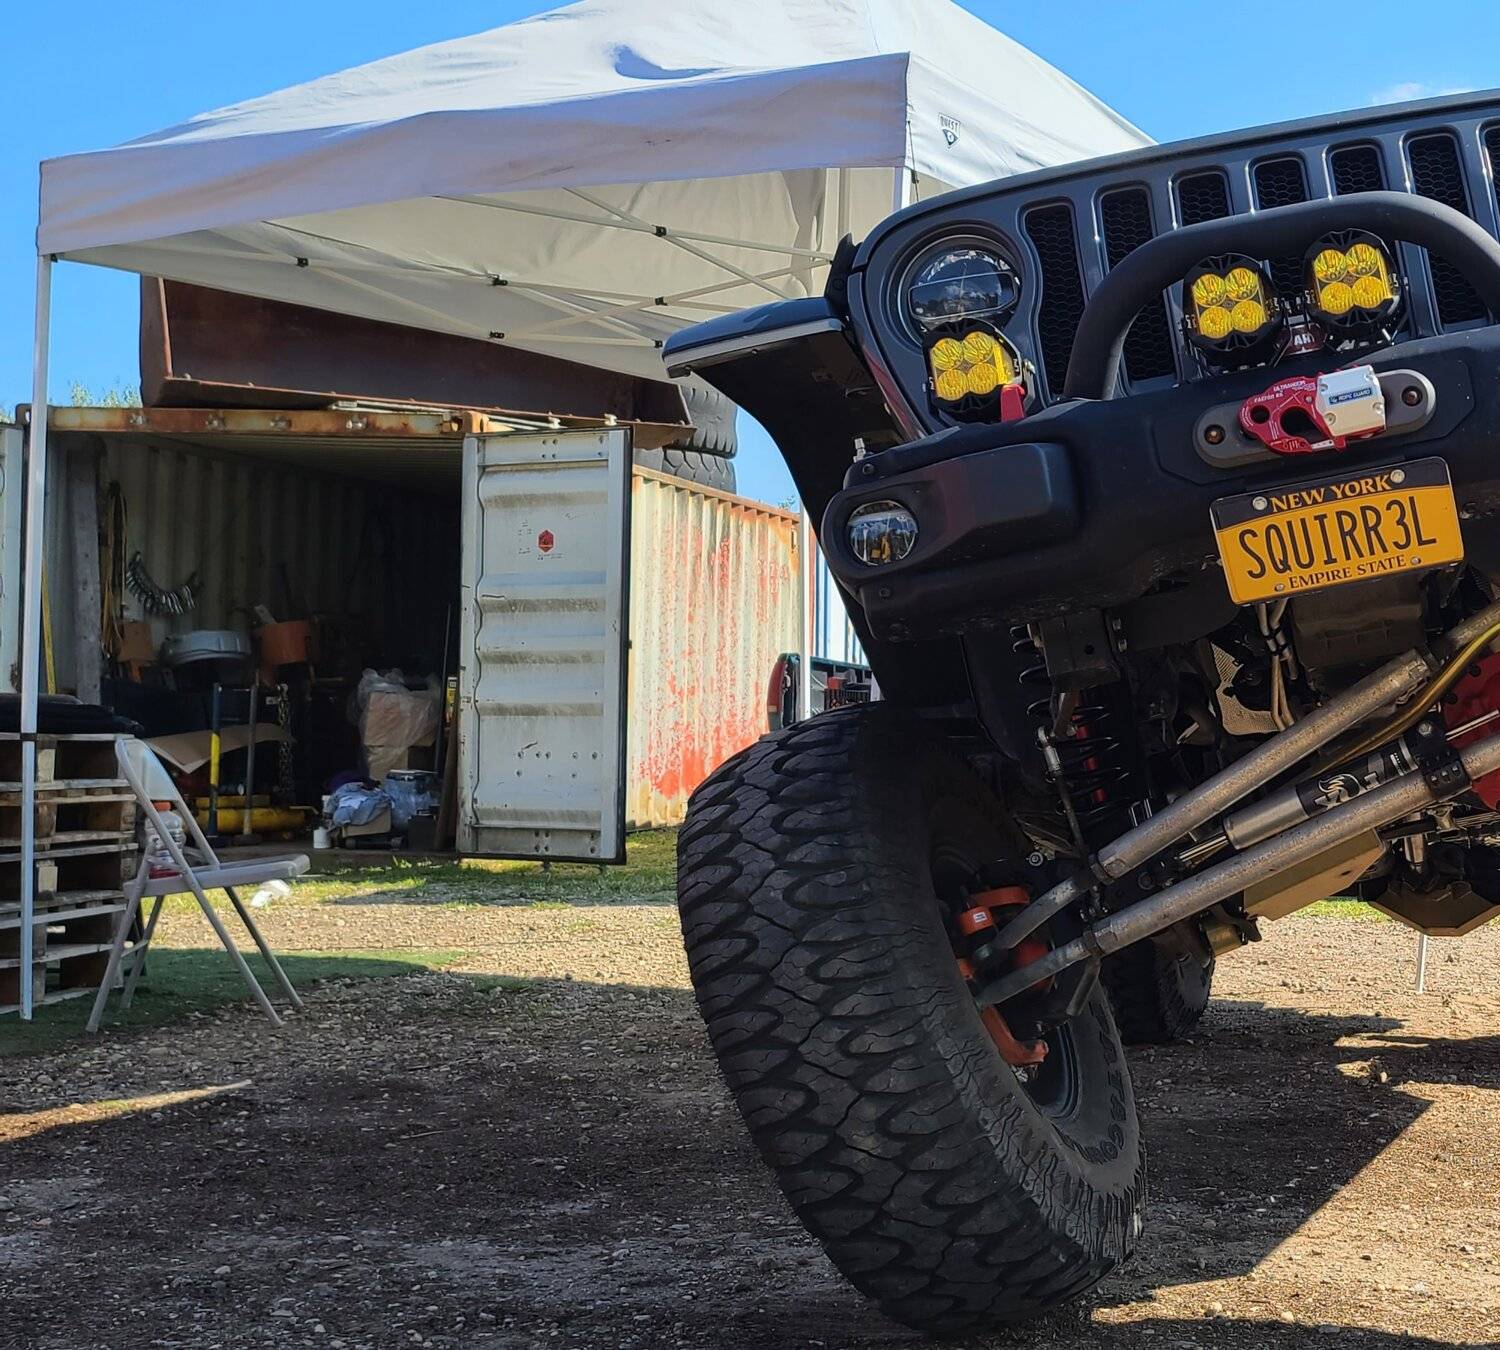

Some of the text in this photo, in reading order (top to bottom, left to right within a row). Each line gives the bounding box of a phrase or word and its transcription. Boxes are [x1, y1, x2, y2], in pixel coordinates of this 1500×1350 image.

[1270, 474, 1392, 513] NEW YORK
[1239, 495, 1437, 579] SQUIRR3L
[1289, 554, 1406, 589] EMPIRE STATE
